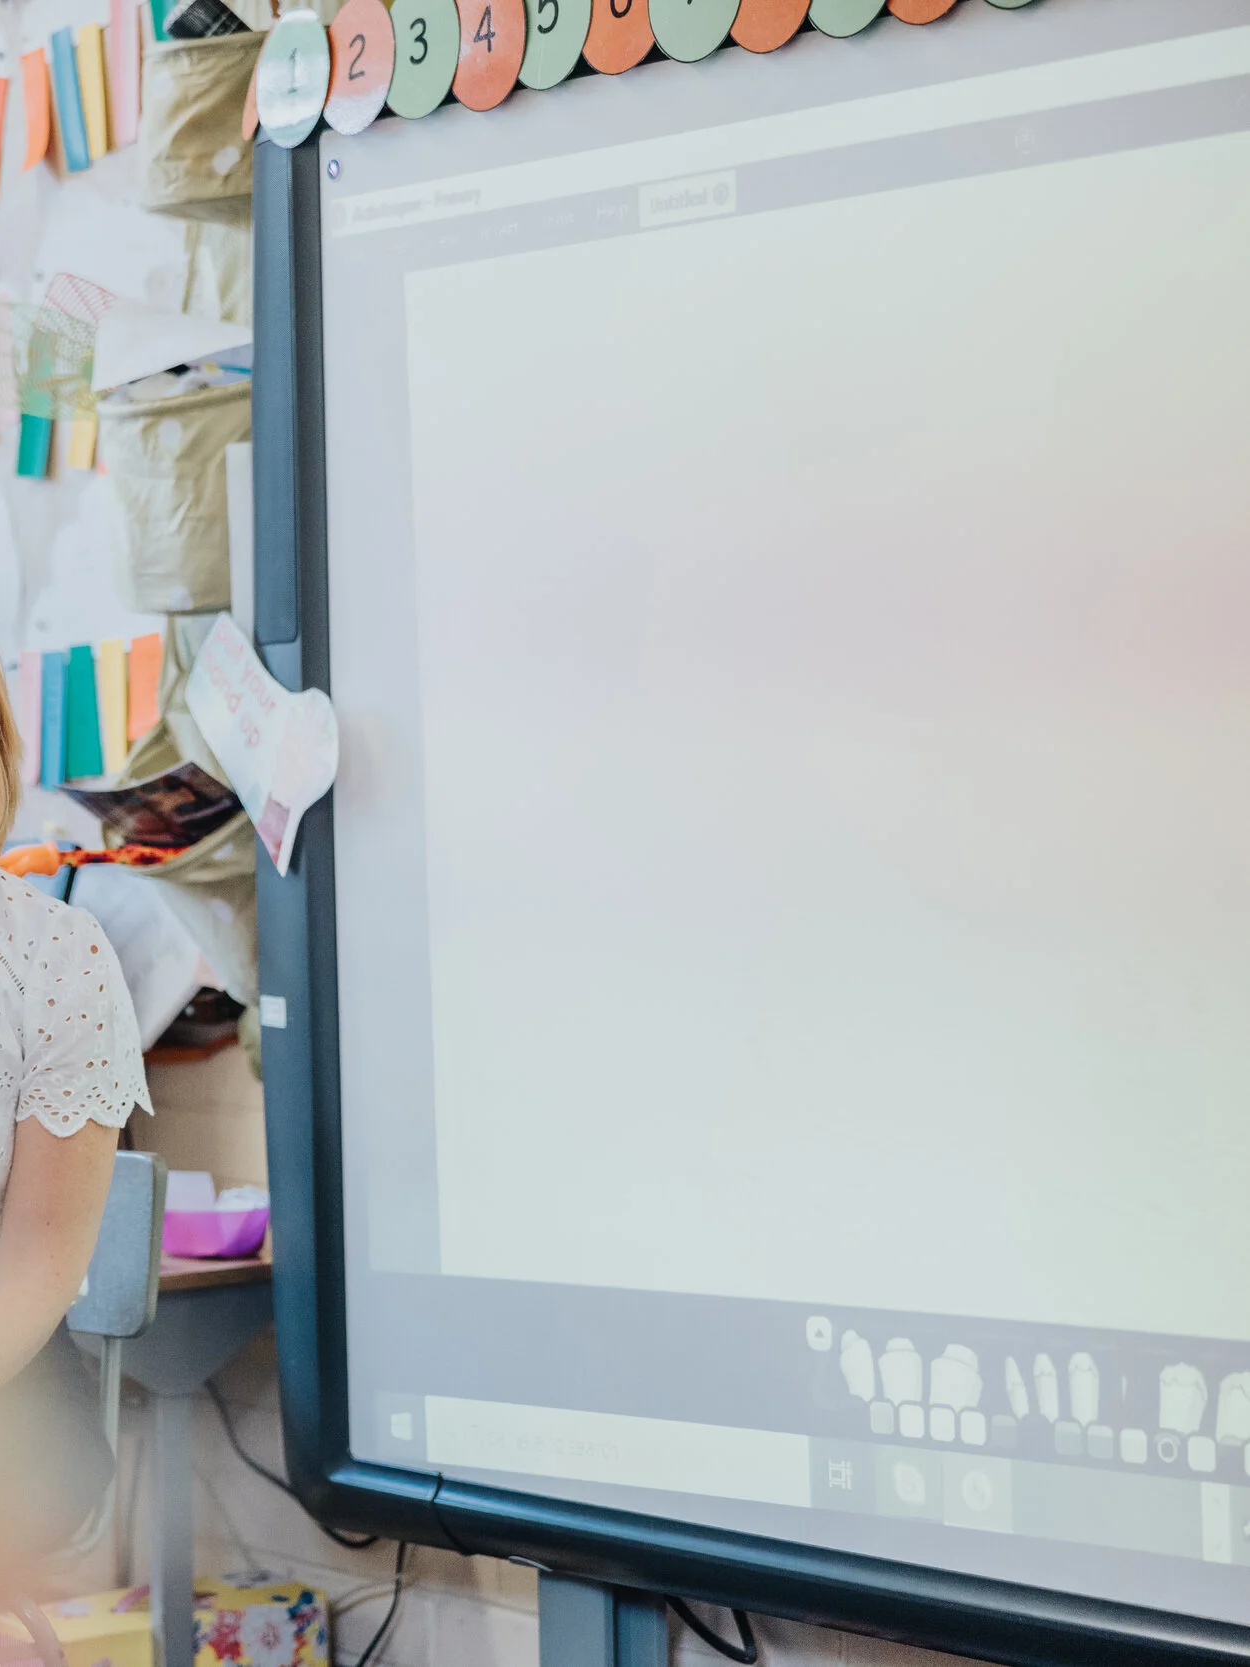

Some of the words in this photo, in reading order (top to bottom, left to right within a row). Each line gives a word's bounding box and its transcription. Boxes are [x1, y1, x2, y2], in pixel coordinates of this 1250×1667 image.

[288, 47, 298, 94] 1
[348, 33, 366, 81] 2
[409, 17, 428, 65] 3
[473, 5, 496, 53] 4
